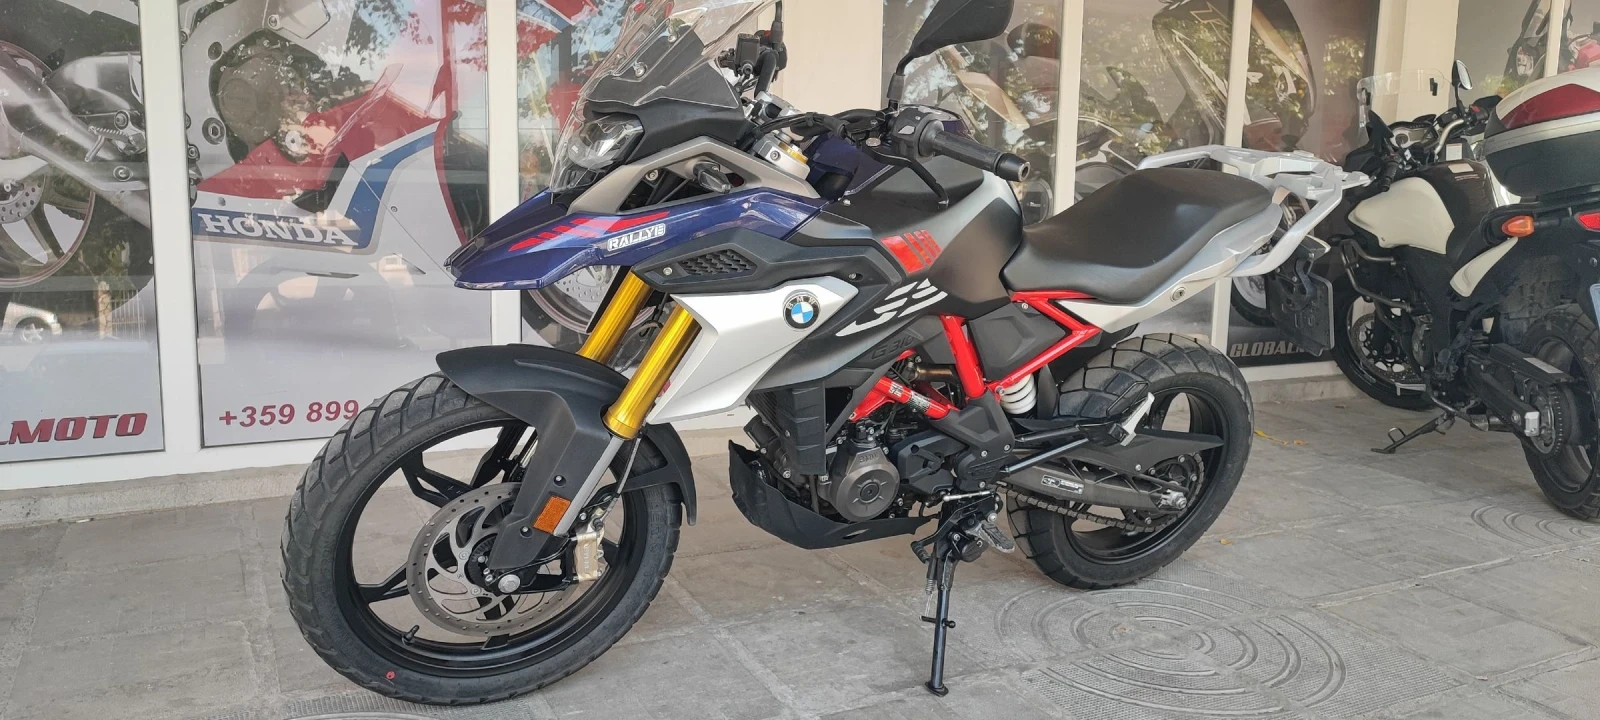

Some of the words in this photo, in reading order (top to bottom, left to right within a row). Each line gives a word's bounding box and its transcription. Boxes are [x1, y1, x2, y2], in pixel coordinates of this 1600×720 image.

[197, 213, 359, 246] HONDA
[608, 223, 666, 250] RALLYE
[785, 296, 818, 310] BMW
[219, 404, 296, 428] +359
[306, 399, 359, 423] 899
[0, 413, 148, 445] MOTO
